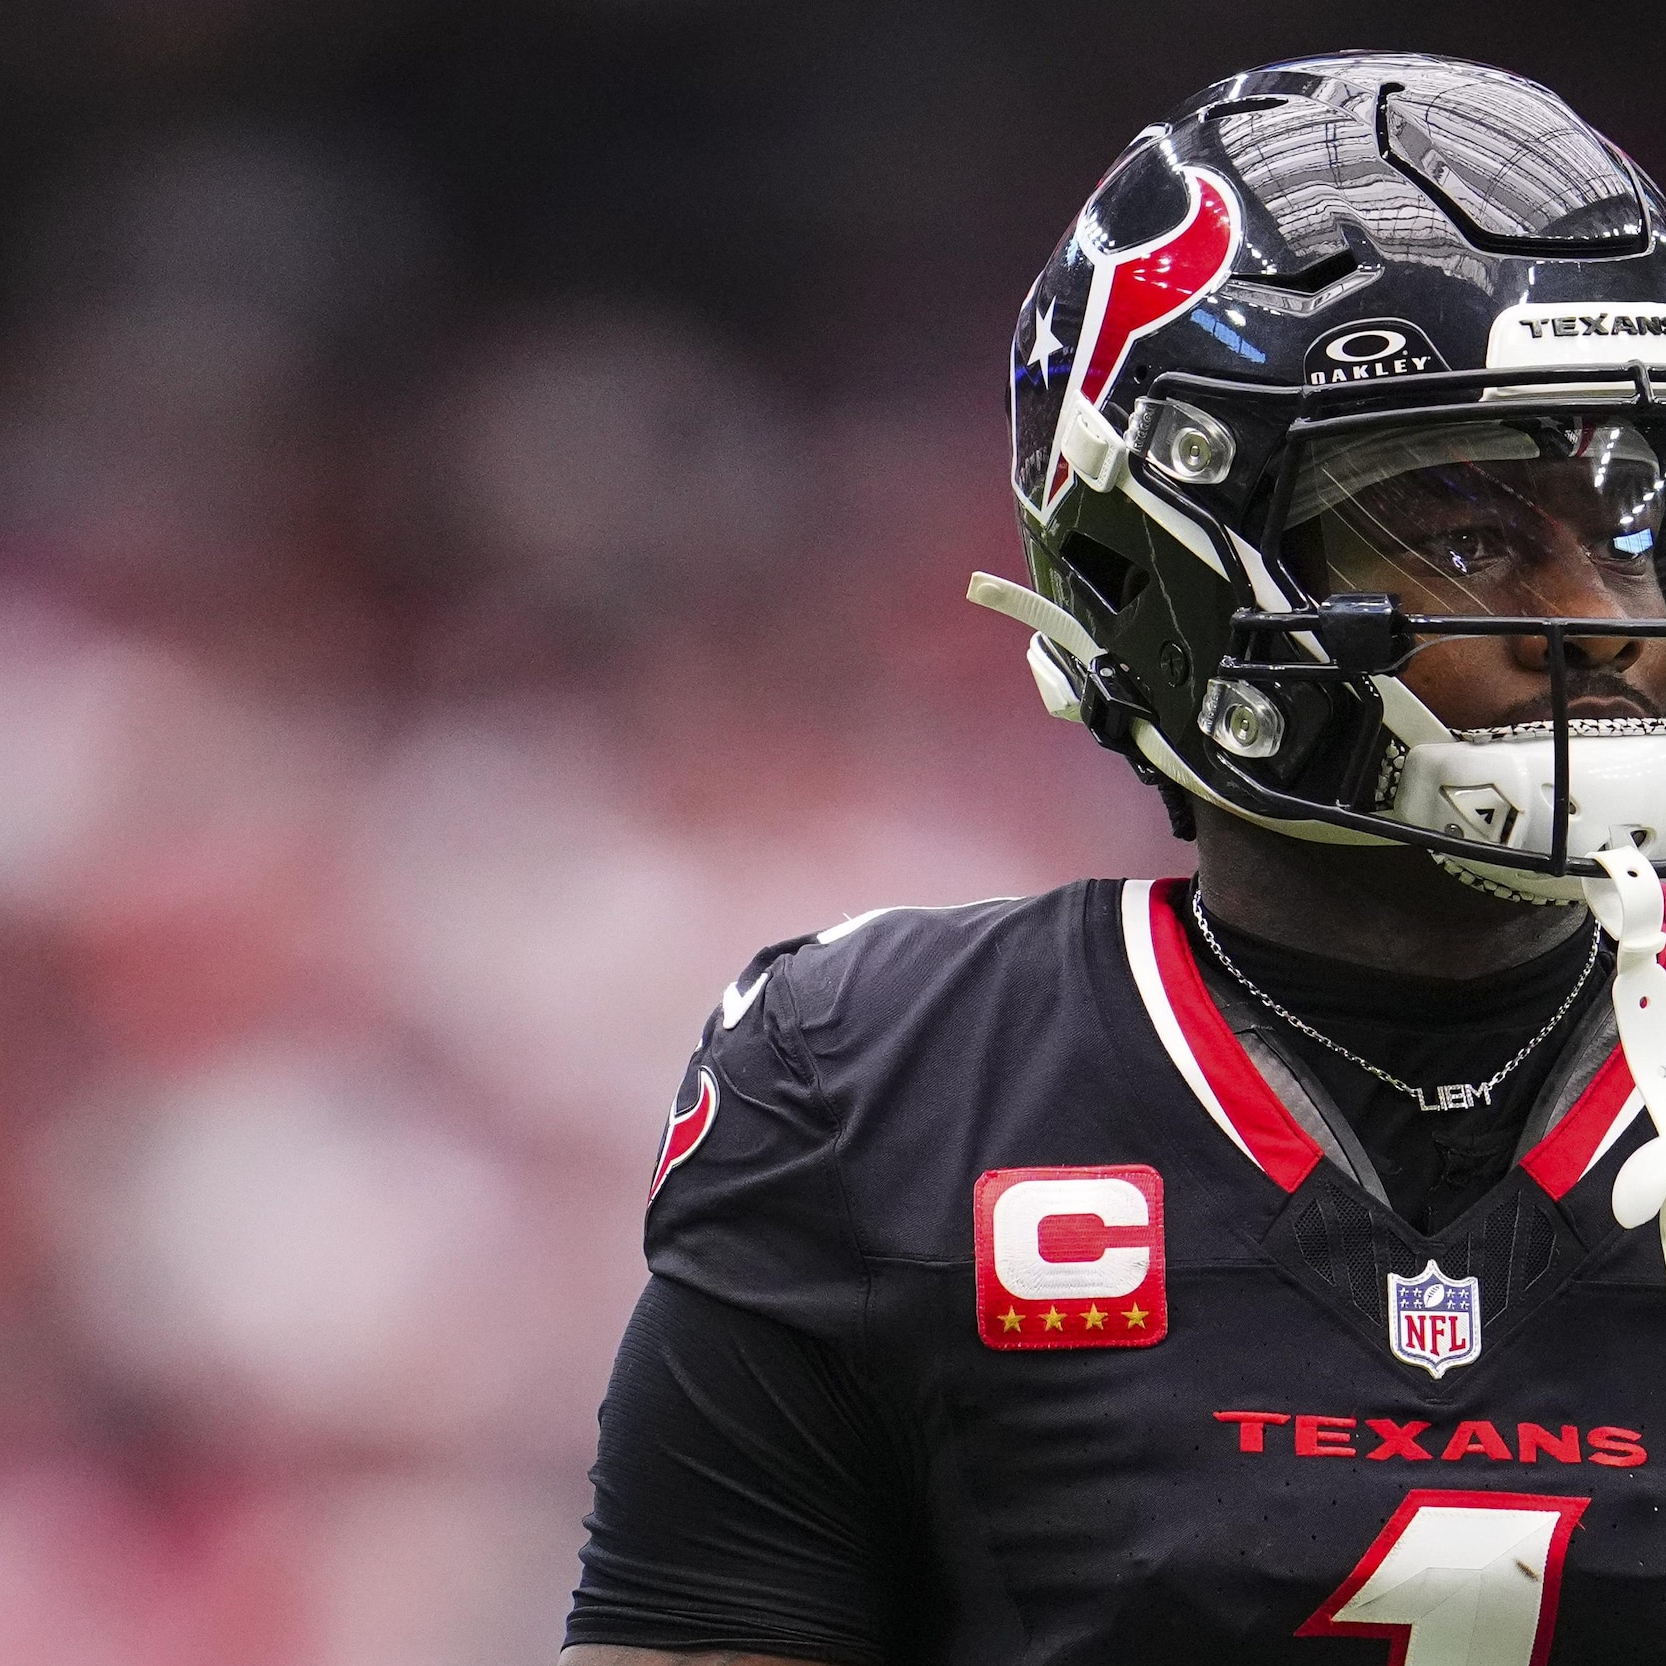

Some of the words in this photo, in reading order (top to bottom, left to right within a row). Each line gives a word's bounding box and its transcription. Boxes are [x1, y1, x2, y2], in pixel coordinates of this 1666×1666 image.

[1311, 357, 1428, 385] OAKLEY
[993, 1178, 1150, 1300] C
[1405, 1315, 1466, 1356] NFL
[1213, 1411, 1648, 1467] TEXANS
